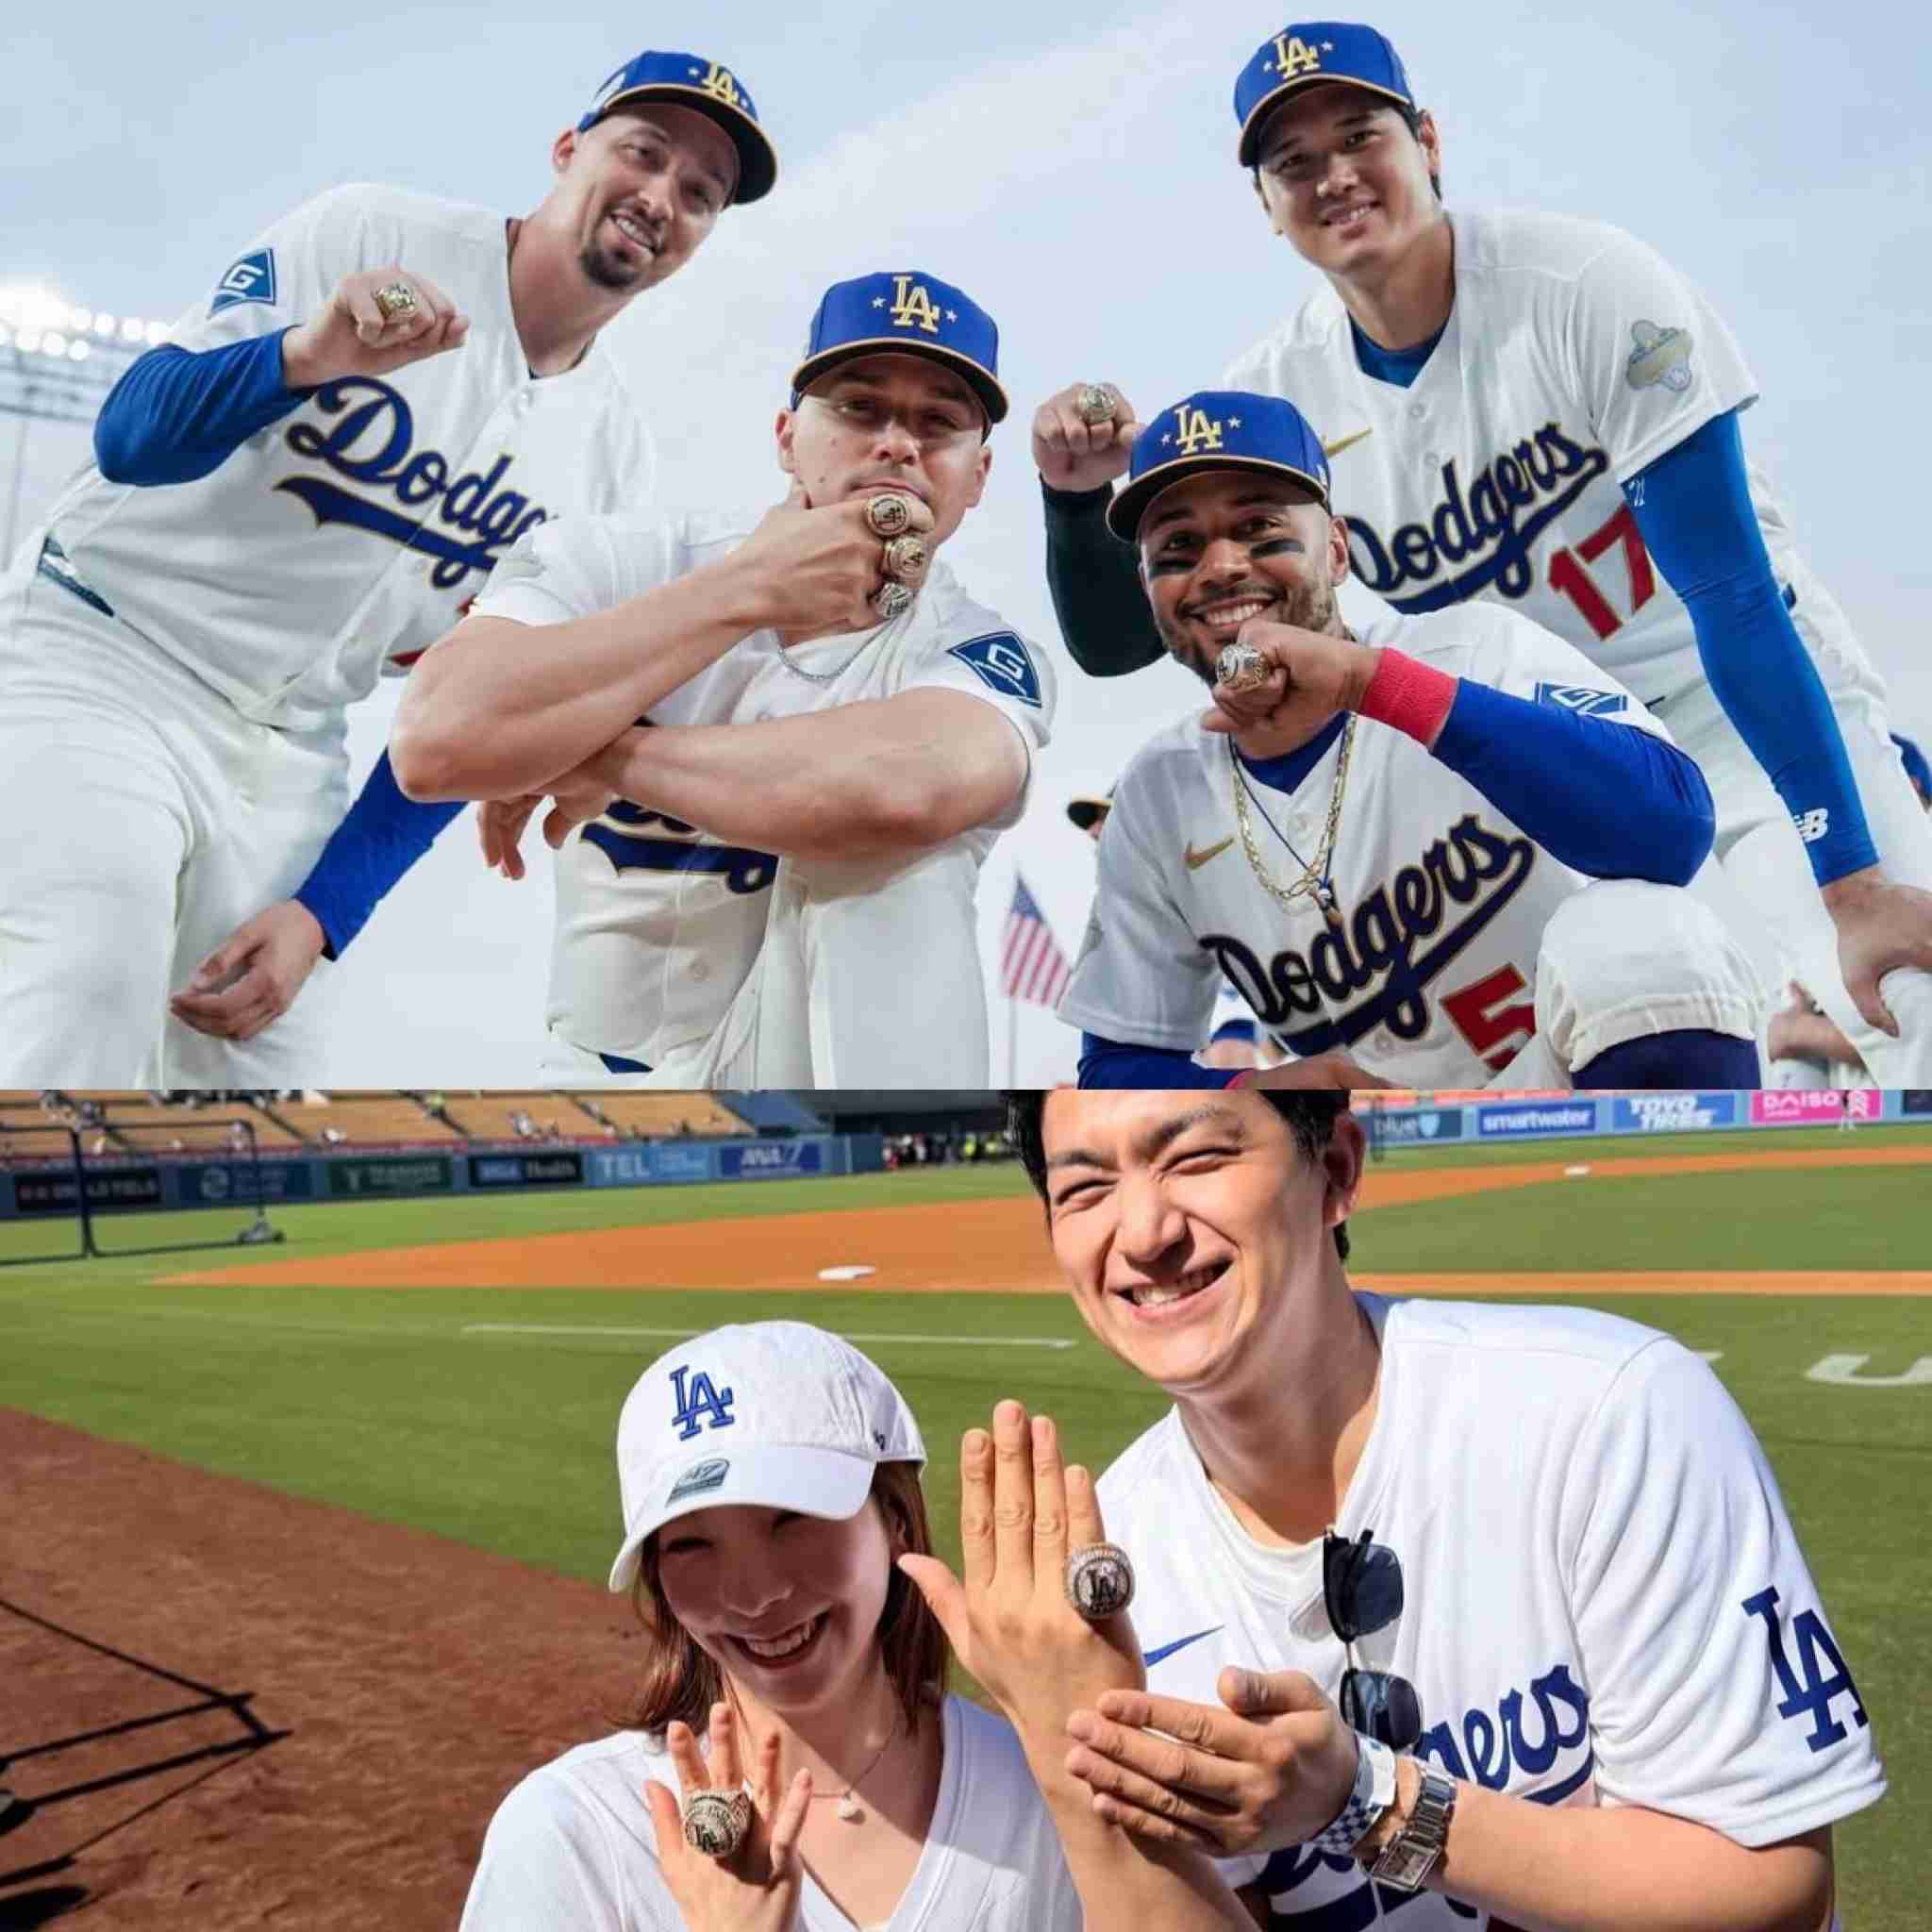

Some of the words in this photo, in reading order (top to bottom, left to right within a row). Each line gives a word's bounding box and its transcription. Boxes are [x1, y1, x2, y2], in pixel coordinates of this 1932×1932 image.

[1274, 34, 1321, 78] LA
[891, 275, 940, 332] LA
[1174, 404, 1223, 455] LA
[1548, 501, 1657, 642] 17
[1198, 813, 1513, 1041] Dodgers
[1483, 1108, 1591, 1131] smartwater
[596, 1153, 651, 1178] TEL
[668, 1364, 736, 1441] LA
[1741, 1584, 1869, 1753] LA
